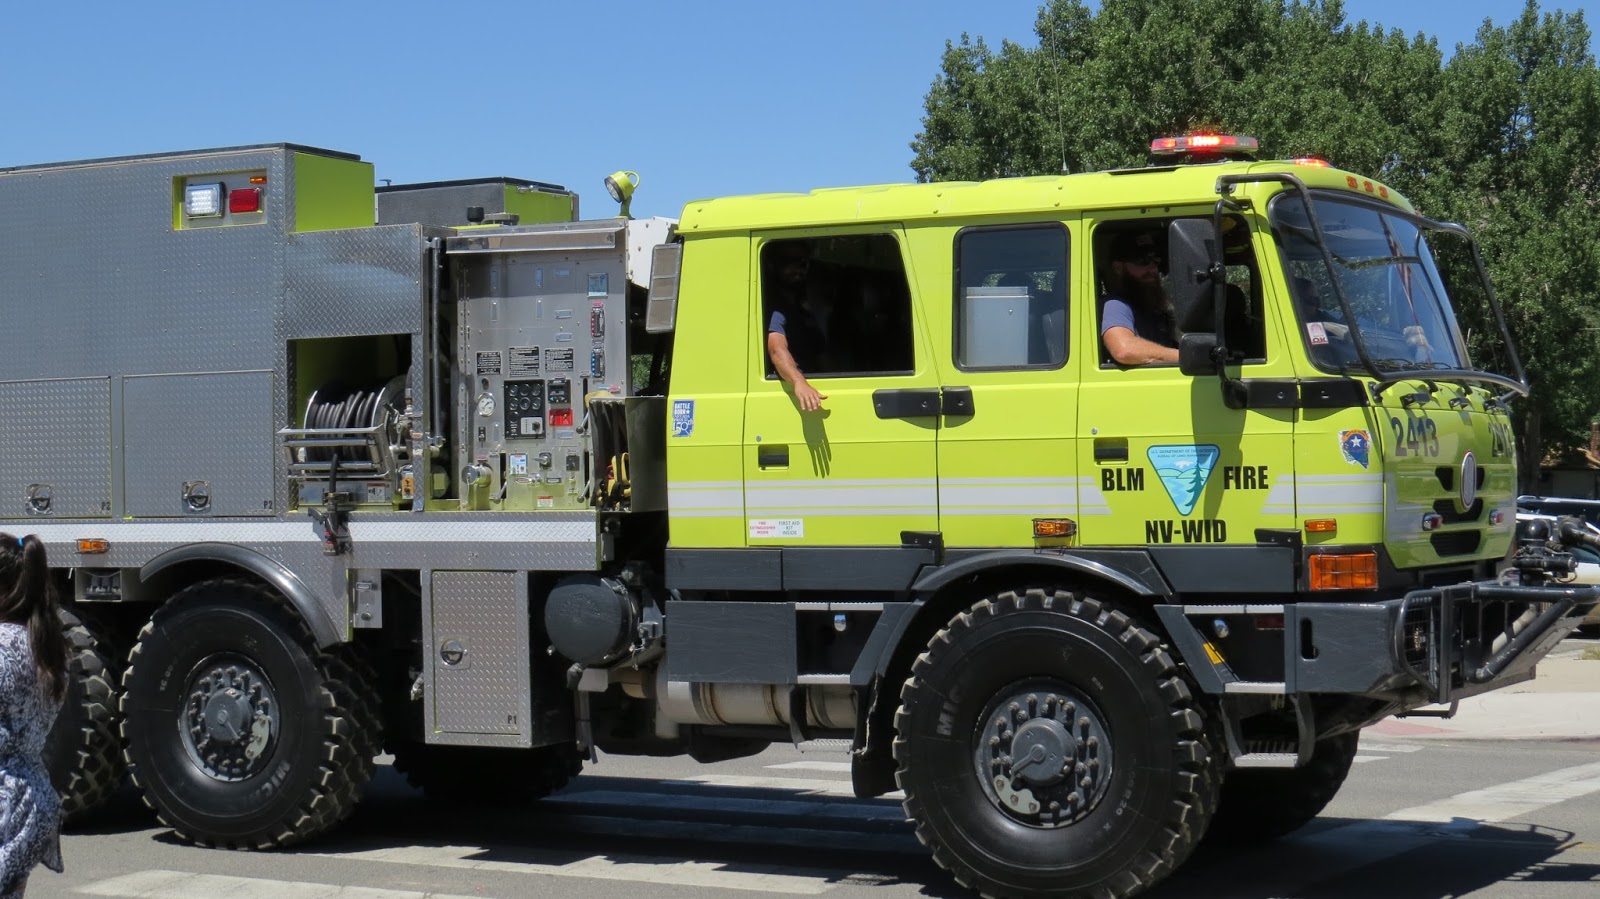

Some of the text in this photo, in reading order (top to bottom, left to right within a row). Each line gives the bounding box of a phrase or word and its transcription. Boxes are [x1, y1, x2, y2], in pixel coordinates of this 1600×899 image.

[1391, 416, 1440, 458] 2413
[1102, 466, 1269, 491] BLM FIRE
[101, 502, 111, 511] P3
[263, 500, 273, 510] P2
[1145, 519, 1227, 544] NV-WID
[507, 715, 517, 725] P1
